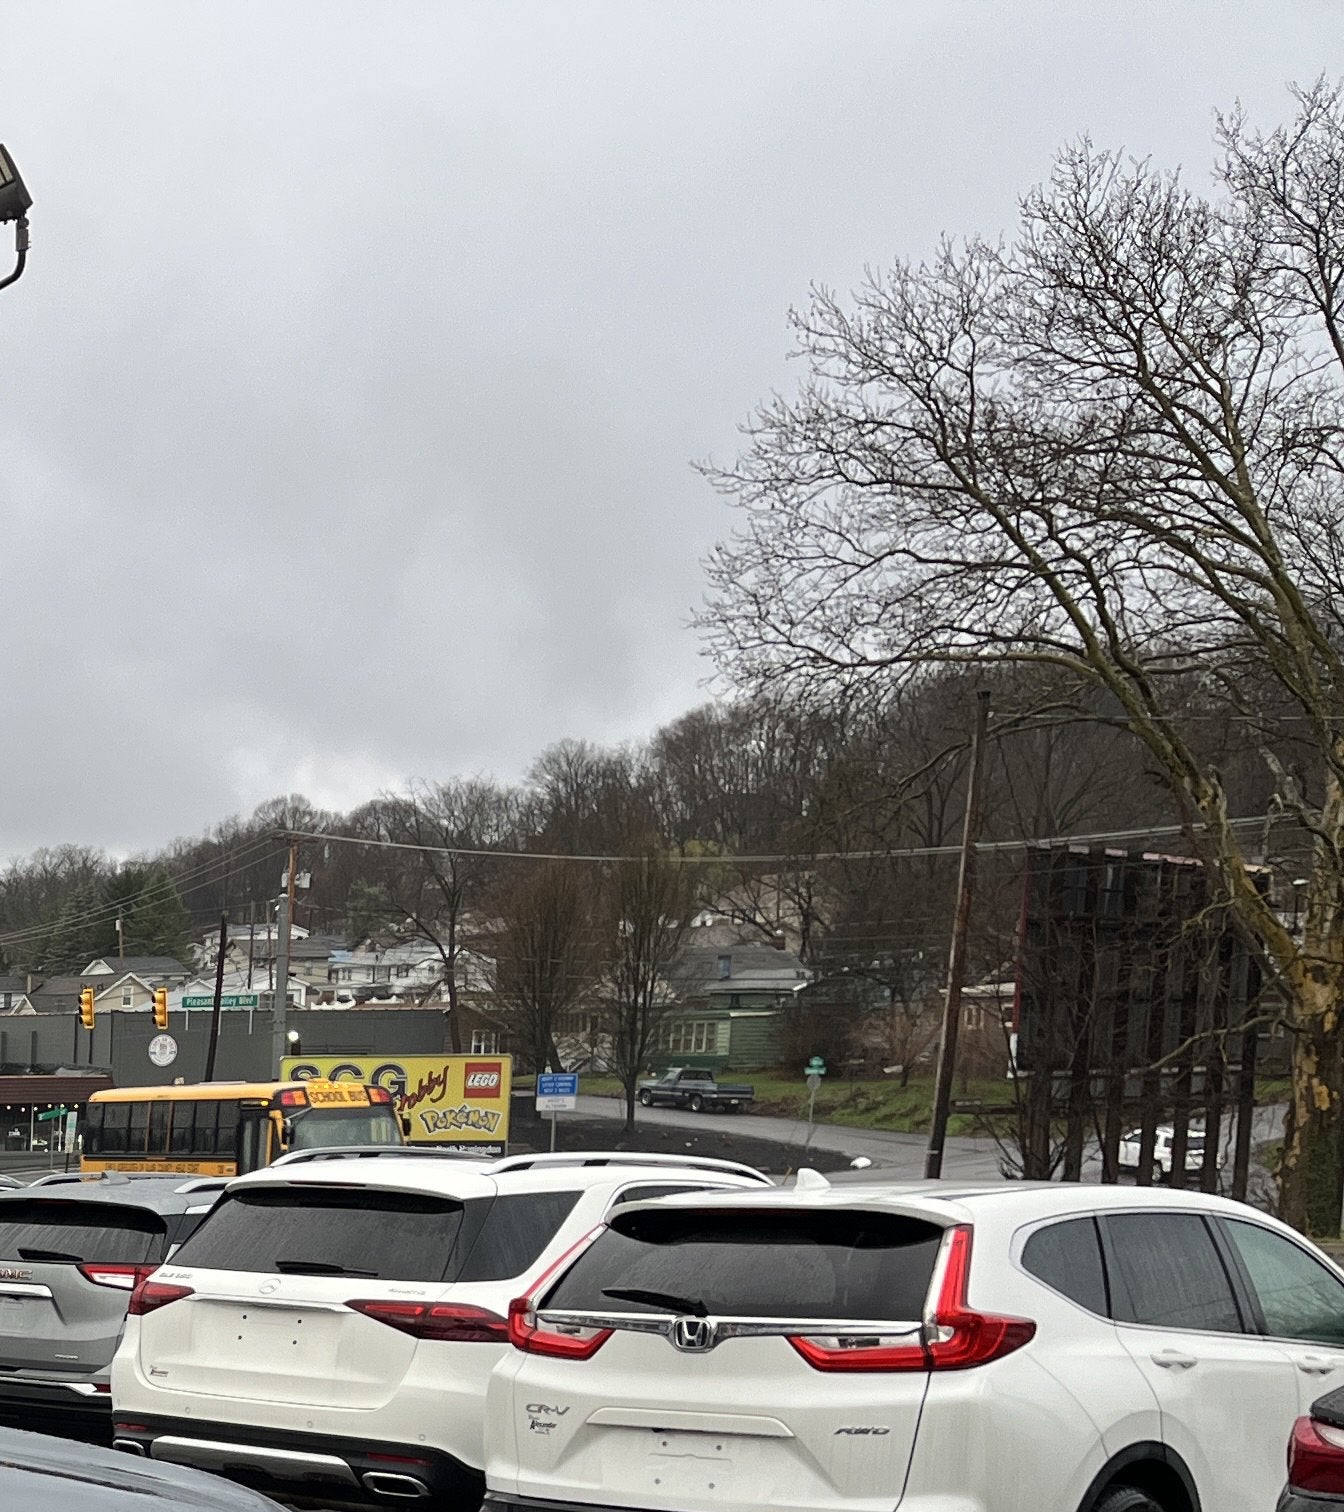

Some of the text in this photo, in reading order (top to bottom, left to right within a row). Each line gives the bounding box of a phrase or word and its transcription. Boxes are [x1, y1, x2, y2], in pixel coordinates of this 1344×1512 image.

[466, 1071, 500, 1088] LEGO
[309, 1091, 347, 1103] SCHOOL
[525, 1403, 571, 1416] CR-V
[833, 1427, 890, 1435] AWD
